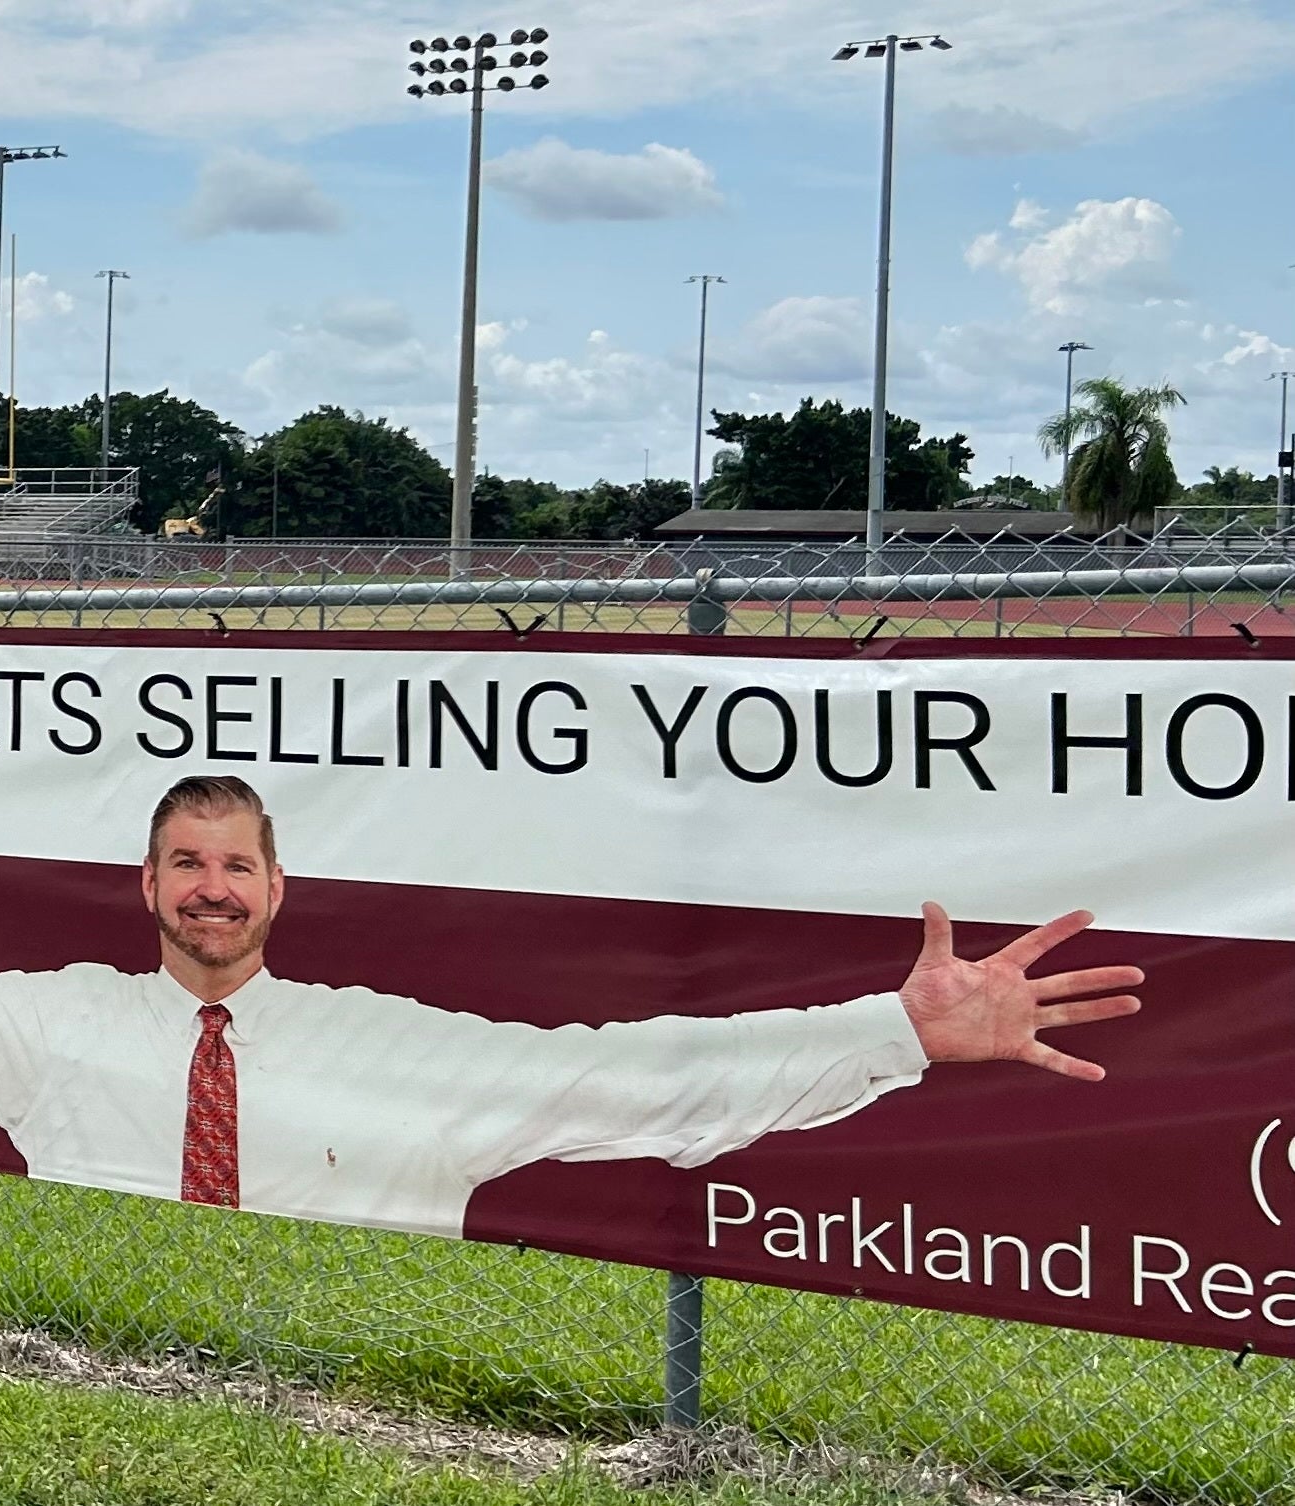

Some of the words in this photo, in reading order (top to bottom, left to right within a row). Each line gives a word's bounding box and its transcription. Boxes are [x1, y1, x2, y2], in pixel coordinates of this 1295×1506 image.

[136, 672, 590, 776] SELLING
[630, 683, 997, 793] YOUR
[1050, 692, 1295, 802] HO
[706, 1182, 1092, 1299] Parkland
